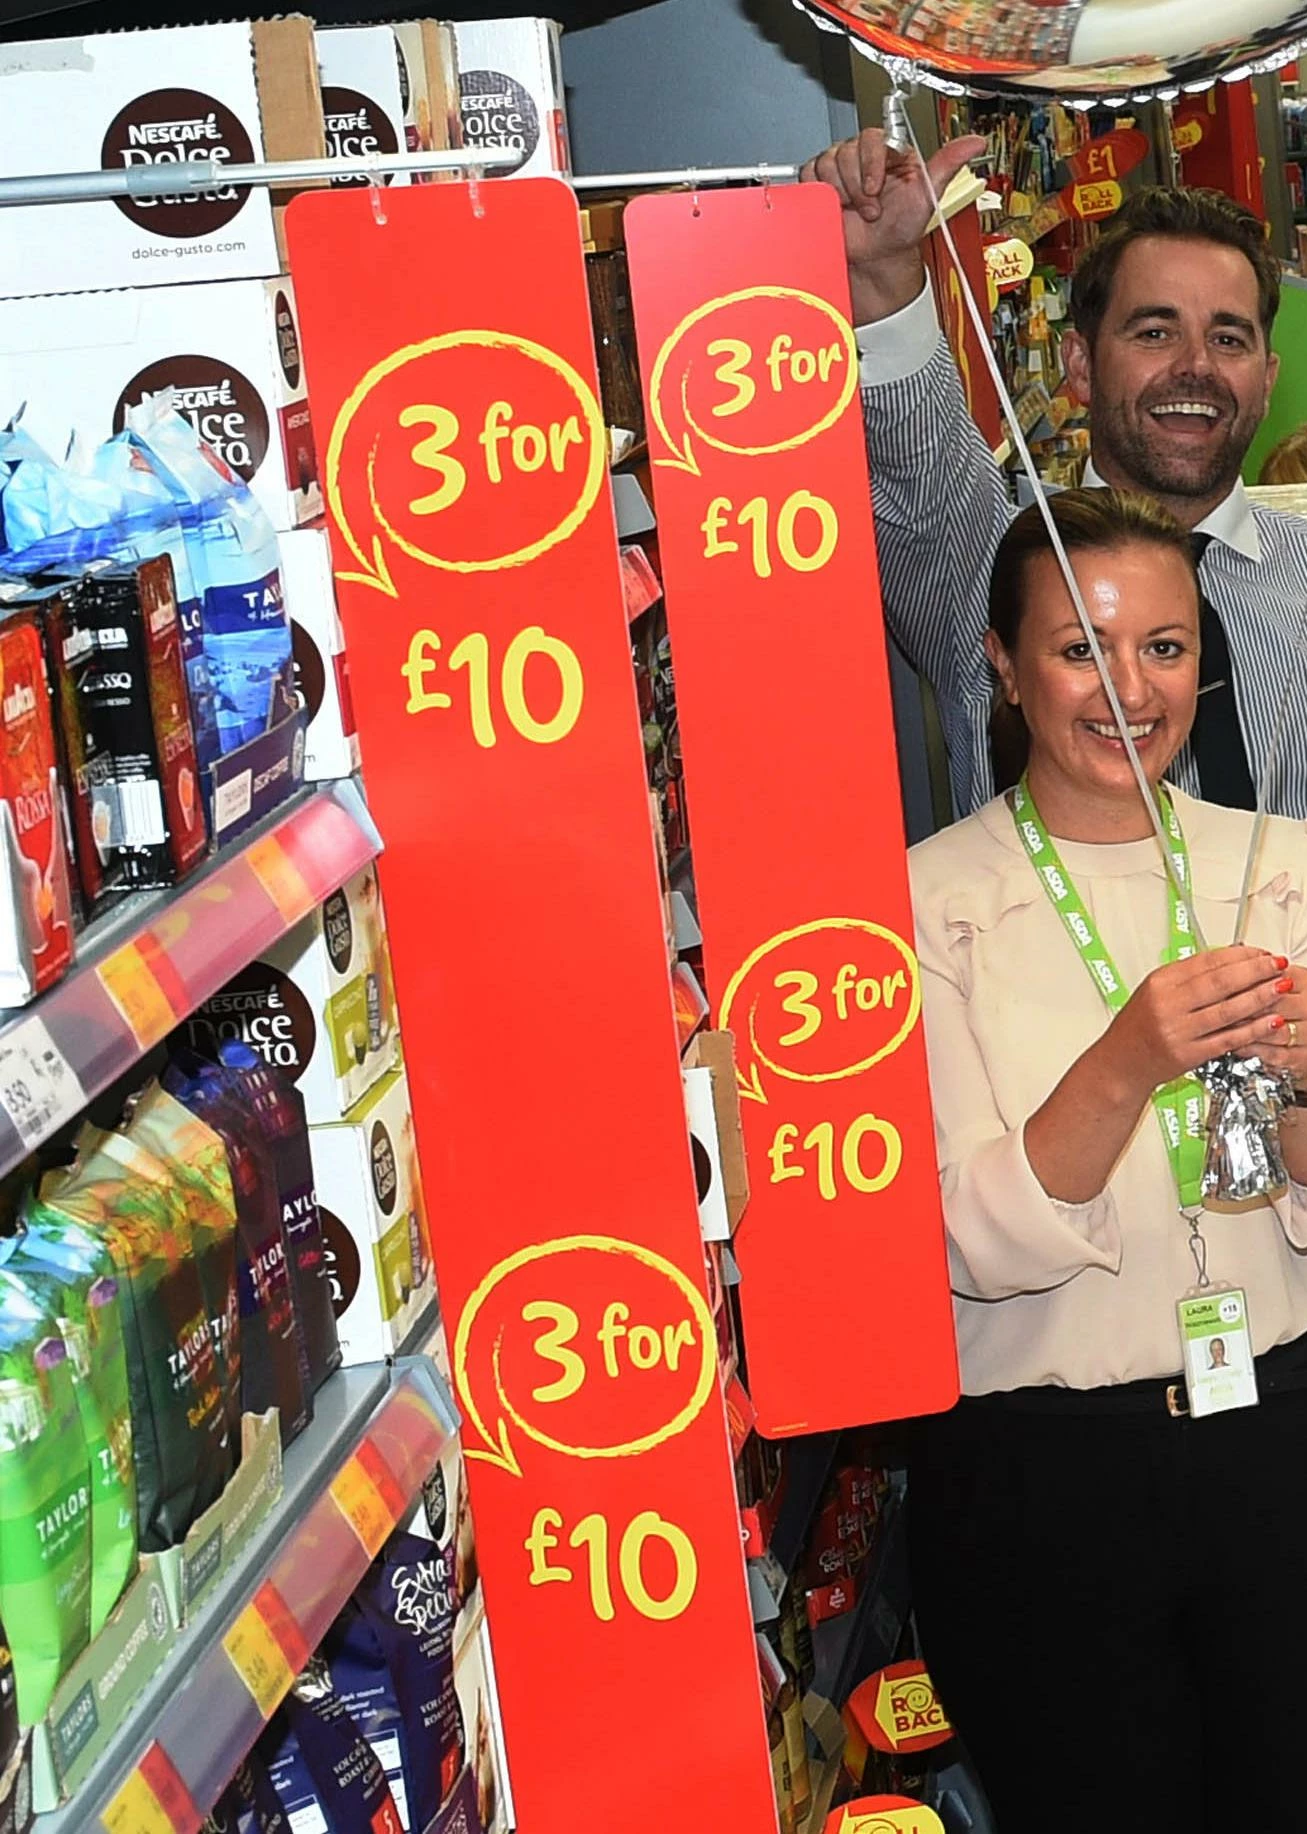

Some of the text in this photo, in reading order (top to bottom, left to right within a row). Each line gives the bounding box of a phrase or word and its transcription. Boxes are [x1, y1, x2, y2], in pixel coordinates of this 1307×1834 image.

[461, 89, 514, 111] ESCAFÉ
[128, 112, 223, 146] NESCAFÉ
[466, 111, 523, 135] olce
[1087, 145, 1117, 178] £1
[1083, 198, 1113, 211] BACK
[131, 241, 246, 260] dolce-gusto.com
[706, 334, 844, 418] 3 for
[399, 400, 585, 516] 3 for
[701, 488, 839, 578] £10
[400, 625, 585, 748] £10
[1021, 819, 1045, 855] ASDA
[1041, 863, 1069, 900] ASDA
[1066, 910, 1093, 947] ASDA
[1091, 957, 1119, 995] ASDA
[774, 963, 908, 1047] 3 for
[768, 1112, 903, 1201] £10
[521, 1300, 697, 1404] 3 for
[36, 1486, 89, 1543] TAYLOR
[524, 1507, 699, 1621] £10
[896, 1708, 944, 1732] BAC
